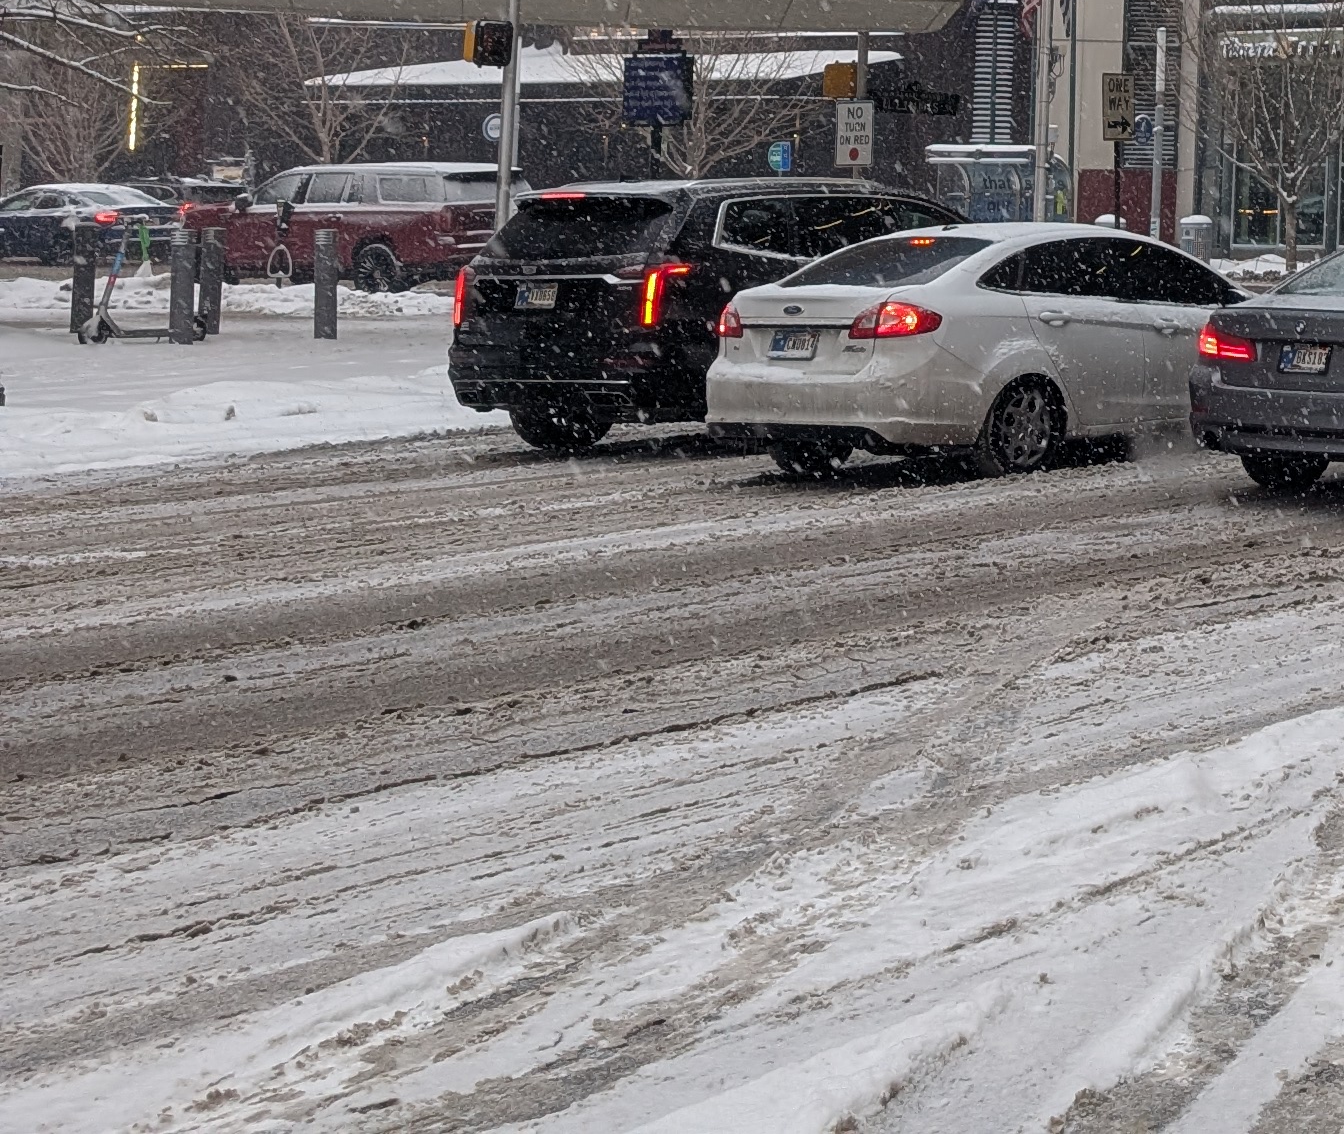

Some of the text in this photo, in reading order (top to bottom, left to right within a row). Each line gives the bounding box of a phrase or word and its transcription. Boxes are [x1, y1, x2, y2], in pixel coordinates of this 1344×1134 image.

[1108, 78, 1130, 93] ONE
[1108, 96, 1131, 111] WAY
[847, 106, 864, 120] NO
[840, 134, 870, 145] ON RED
